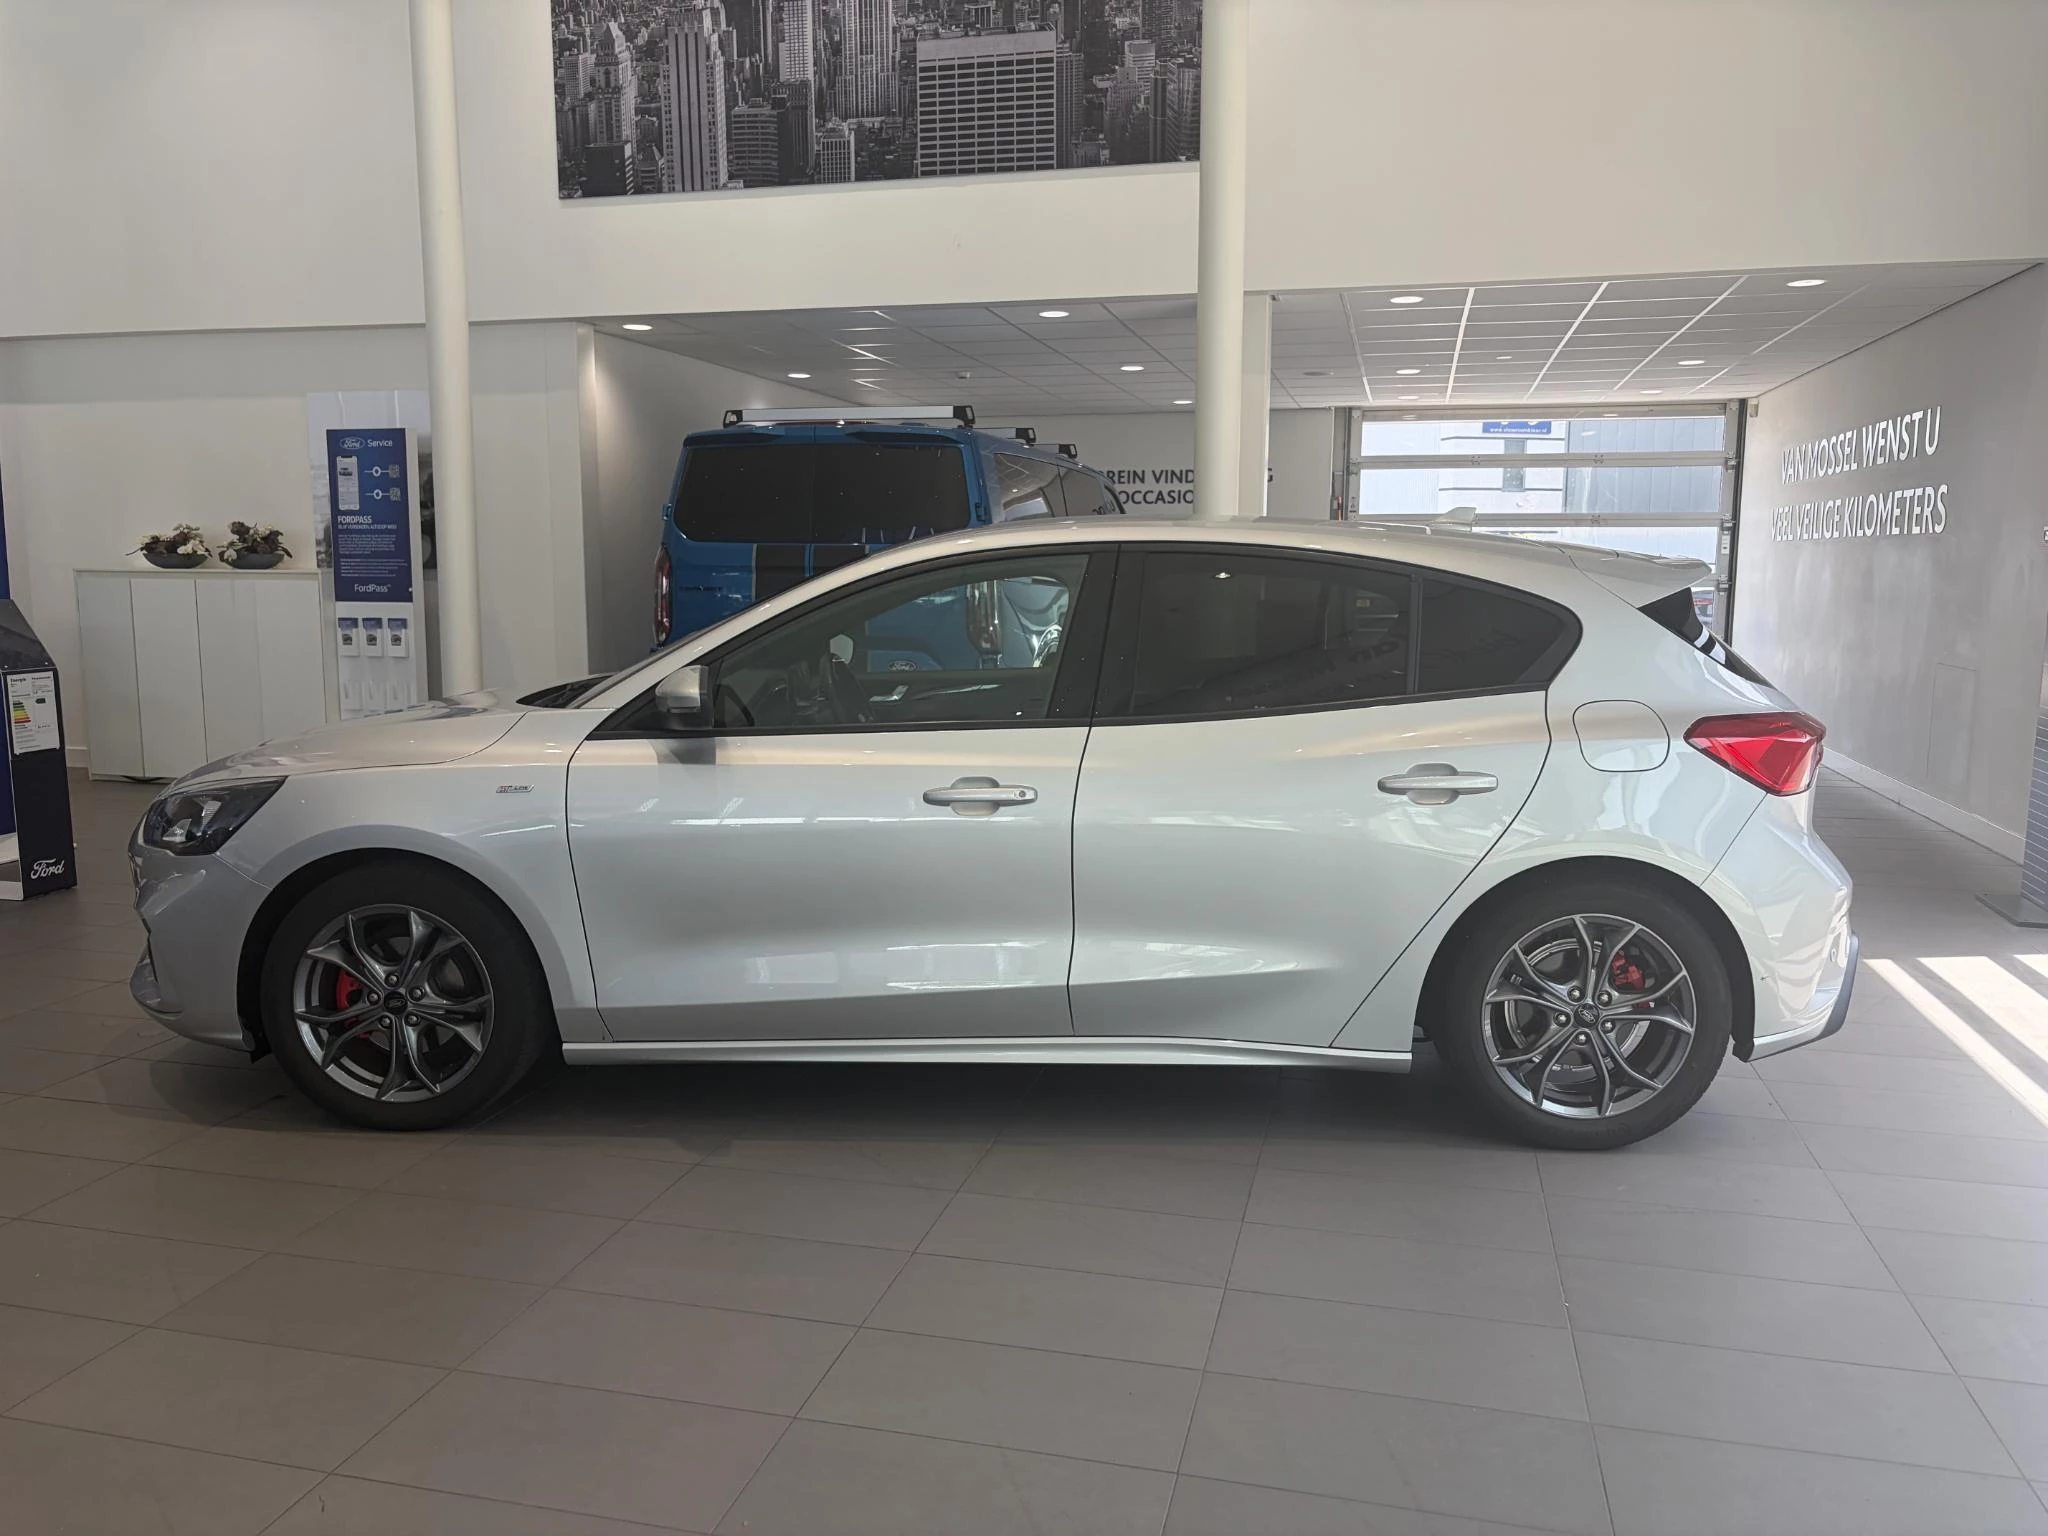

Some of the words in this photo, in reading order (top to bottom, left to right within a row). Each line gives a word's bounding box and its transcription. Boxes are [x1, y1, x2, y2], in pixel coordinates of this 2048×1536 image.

[367, 439, 393, 448] Service
[1782, 446, 1806, 485] VAN
[1806, 429, 1858, 479] MOSSEL
[1862, 410, 1924, 468] WENST
[1925, 406, 1942, 456] U
[1099, 470, 1145, 484] REIN
[1152, 469, 1194, 484] VIND
[338, 515, 372, 524] FORDPASS
[1771, 507, 1794, 542] VEEL
[1797, 498, 1842, 541] VEILIGE
[1843, 484, 1949, 537] KILOMETERS
[31, 858, 65, 880] Ford
